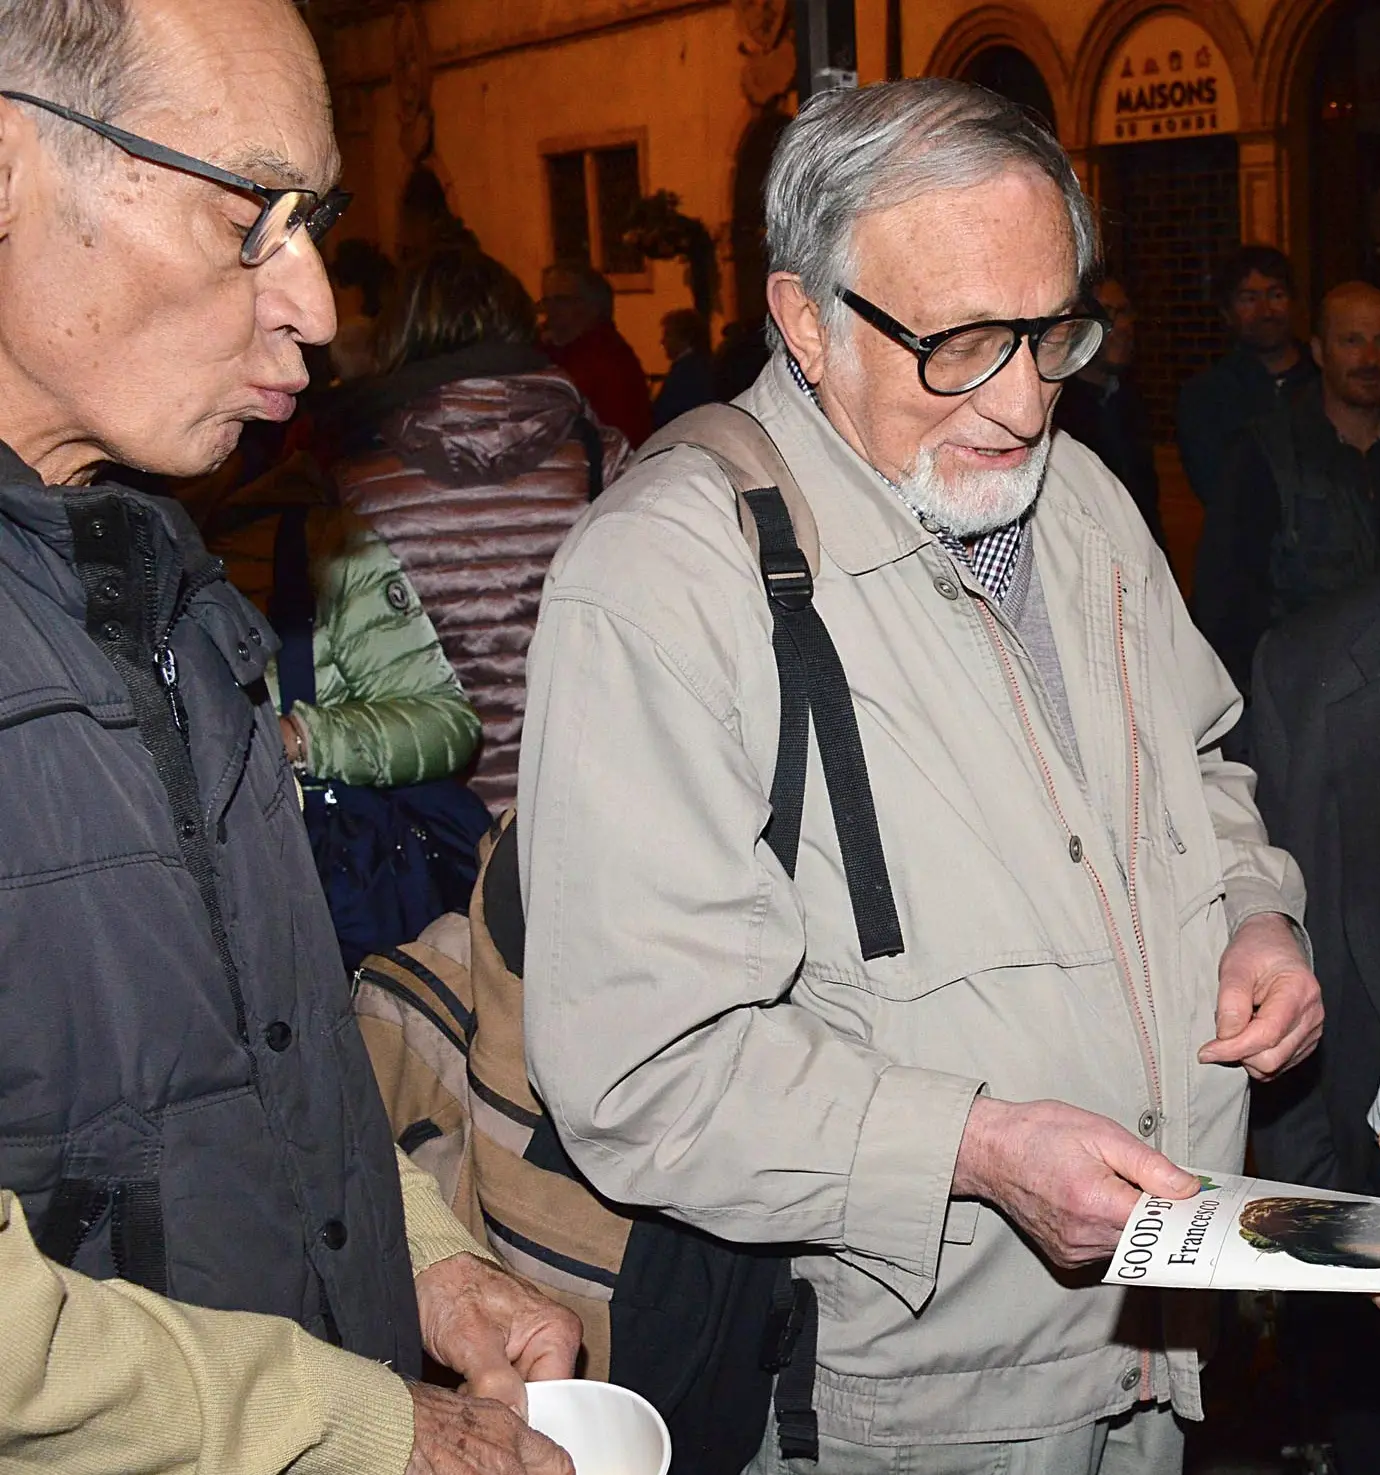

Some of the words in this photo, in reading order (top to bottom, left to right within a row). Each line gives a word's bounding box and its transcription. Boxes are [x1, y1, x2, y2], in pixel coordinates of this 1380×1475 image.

[1115, 76, 1217, 114] MAISONS
[1152, 113, 1217, 135] MONDE
[1167, 1200, 1220, 1265] Francesco
